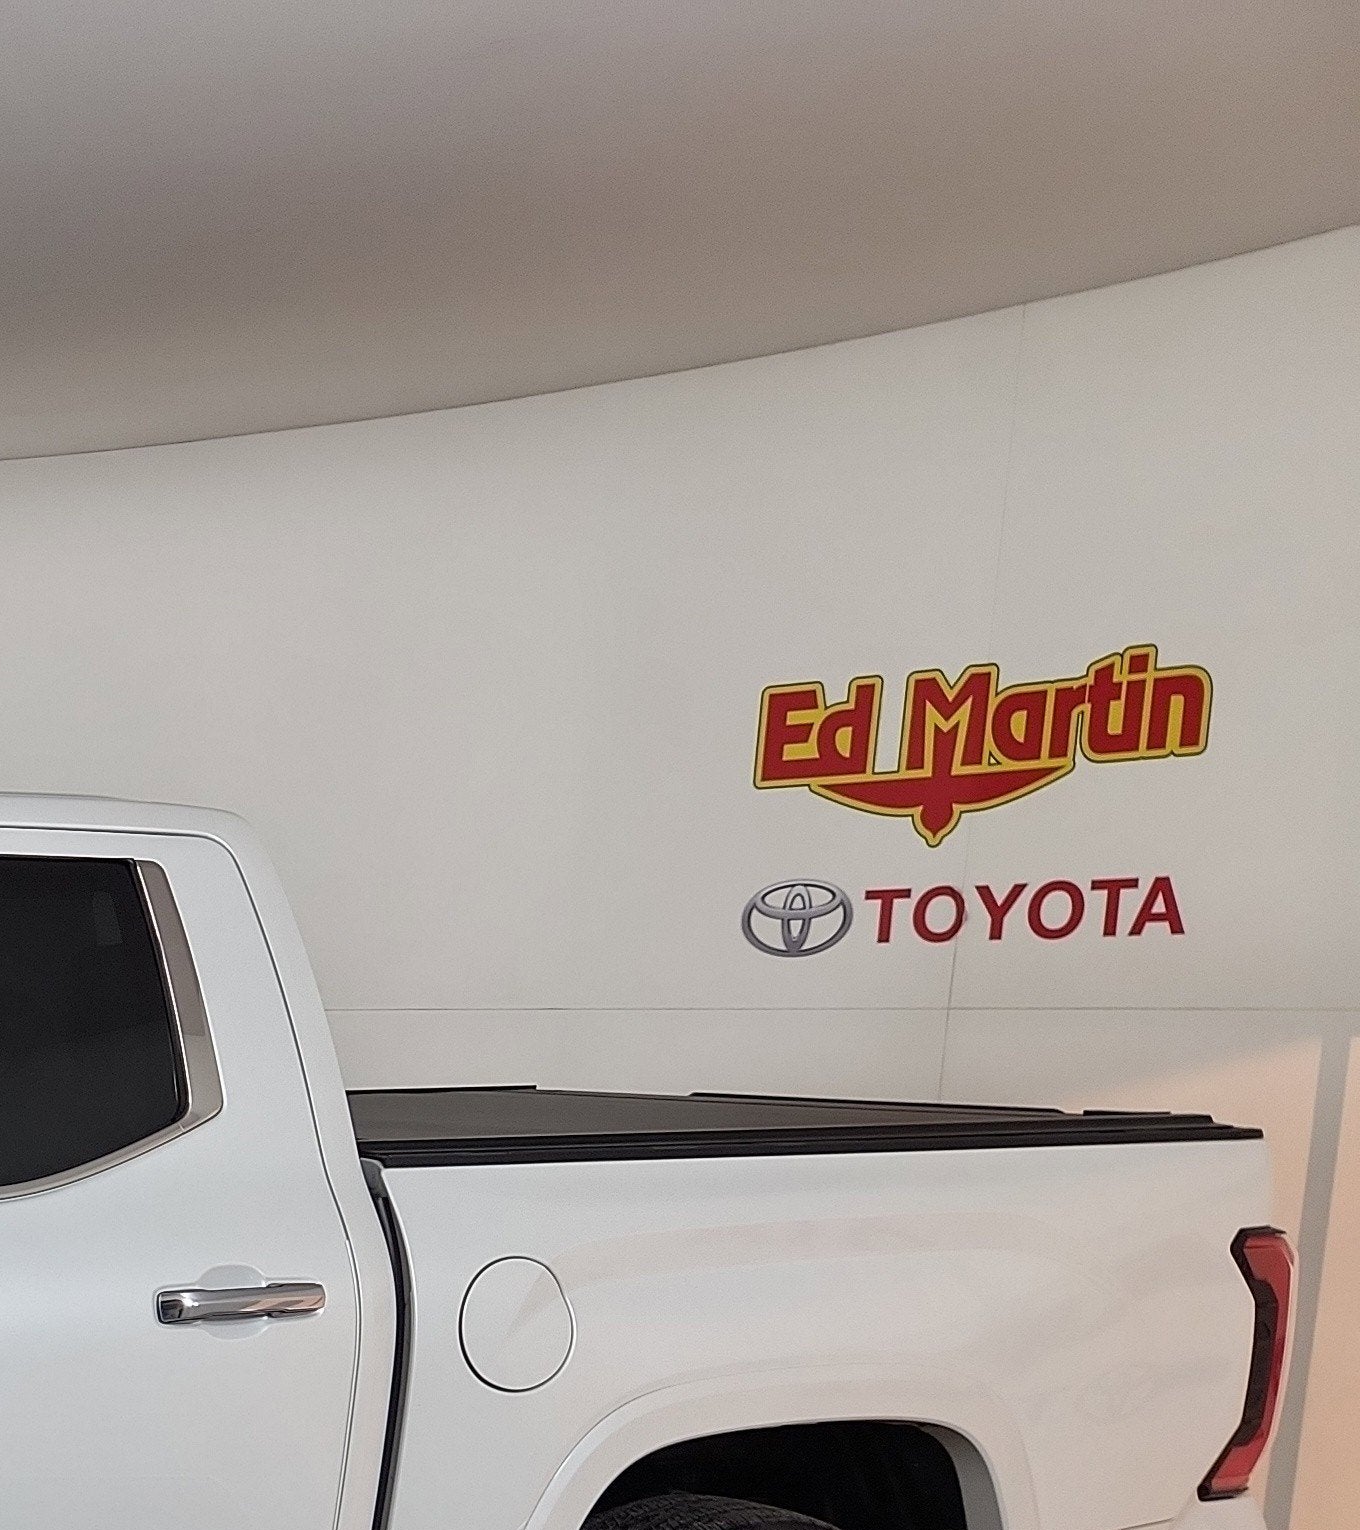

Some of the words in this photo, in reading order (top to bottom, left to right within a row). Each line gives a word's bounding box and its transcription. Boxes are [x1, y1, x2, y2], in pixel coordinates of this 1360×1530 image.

[757, 678, 881, 785] Ed
[904, 648, 1210, 776] Martin
[865, 876, 1185, 943] TOYOTA
